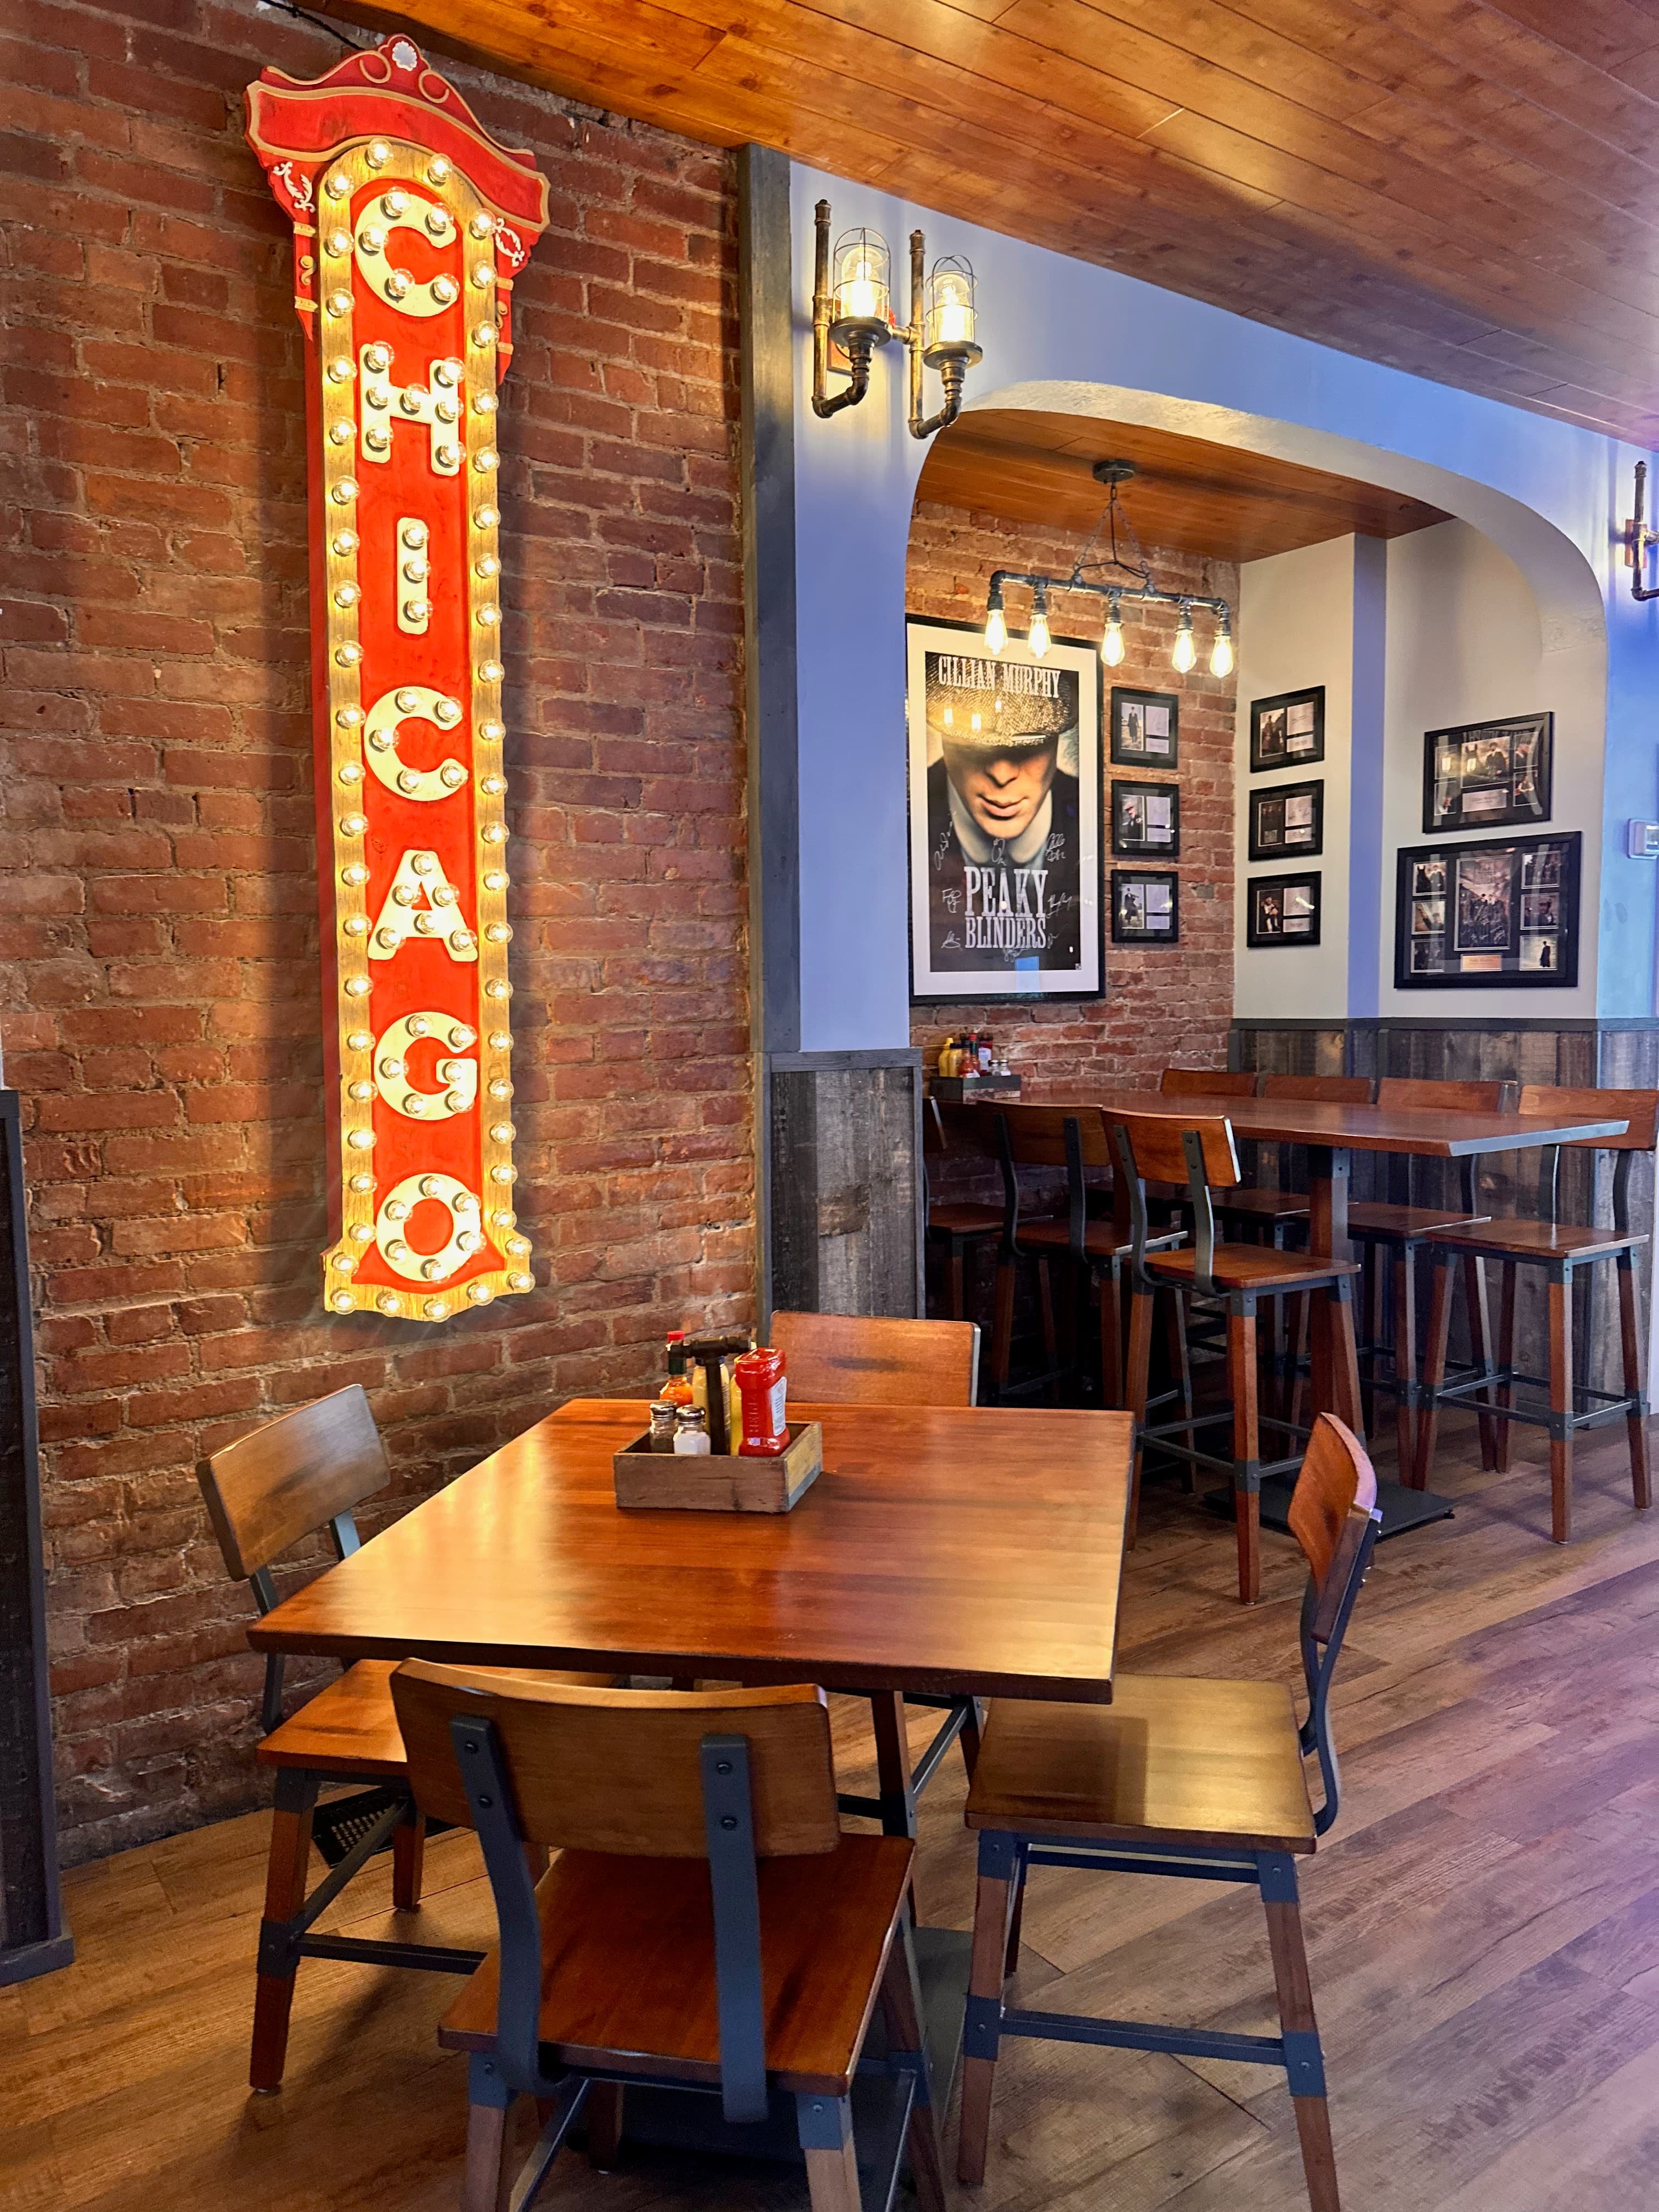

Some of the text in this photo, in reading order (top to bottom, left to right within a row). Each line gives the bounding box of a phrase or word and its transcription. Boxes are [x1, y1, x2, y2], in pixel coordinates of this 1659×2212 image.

[939, 656, 1061, 698] CILLIAN MURPHY
[354, 193, 481, 1282] CHICAGO
[964, 866, 1048, 918] PEAKY
[965, 916, 1047, 949] BLINDERS
